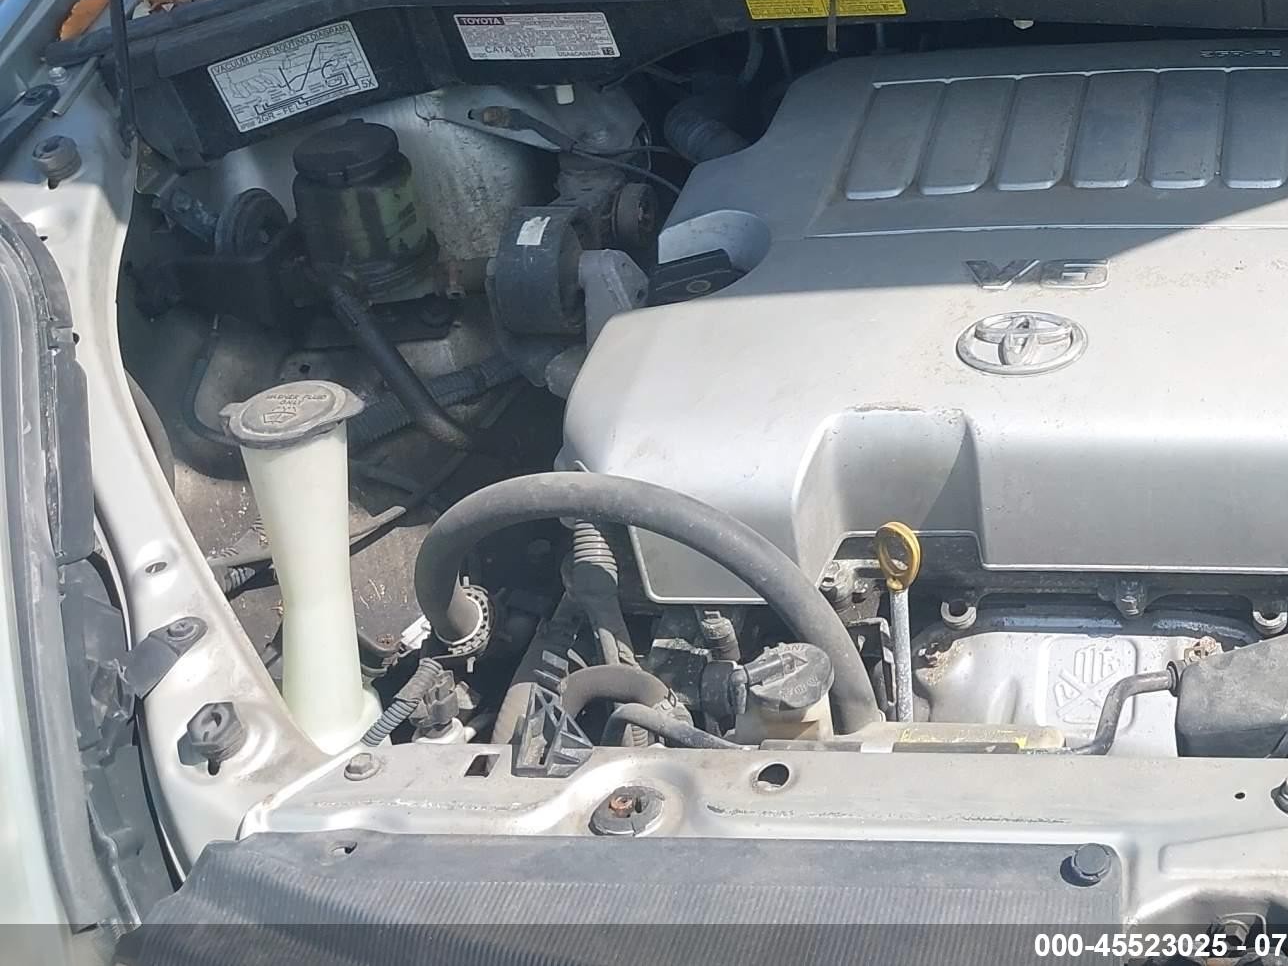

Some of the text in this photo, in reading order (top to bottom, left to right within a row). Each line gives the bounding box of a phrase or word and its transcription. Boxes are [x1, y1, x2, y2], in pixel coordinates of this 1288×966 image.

[461, 17, 500, 25] TOYOTA
[214, 25, 348, 75] VACUUM HOSE ROUTING DIAGRAM
[485, 45, 536, 54] CATALYST
[965, 259, 1110, 290] V6
